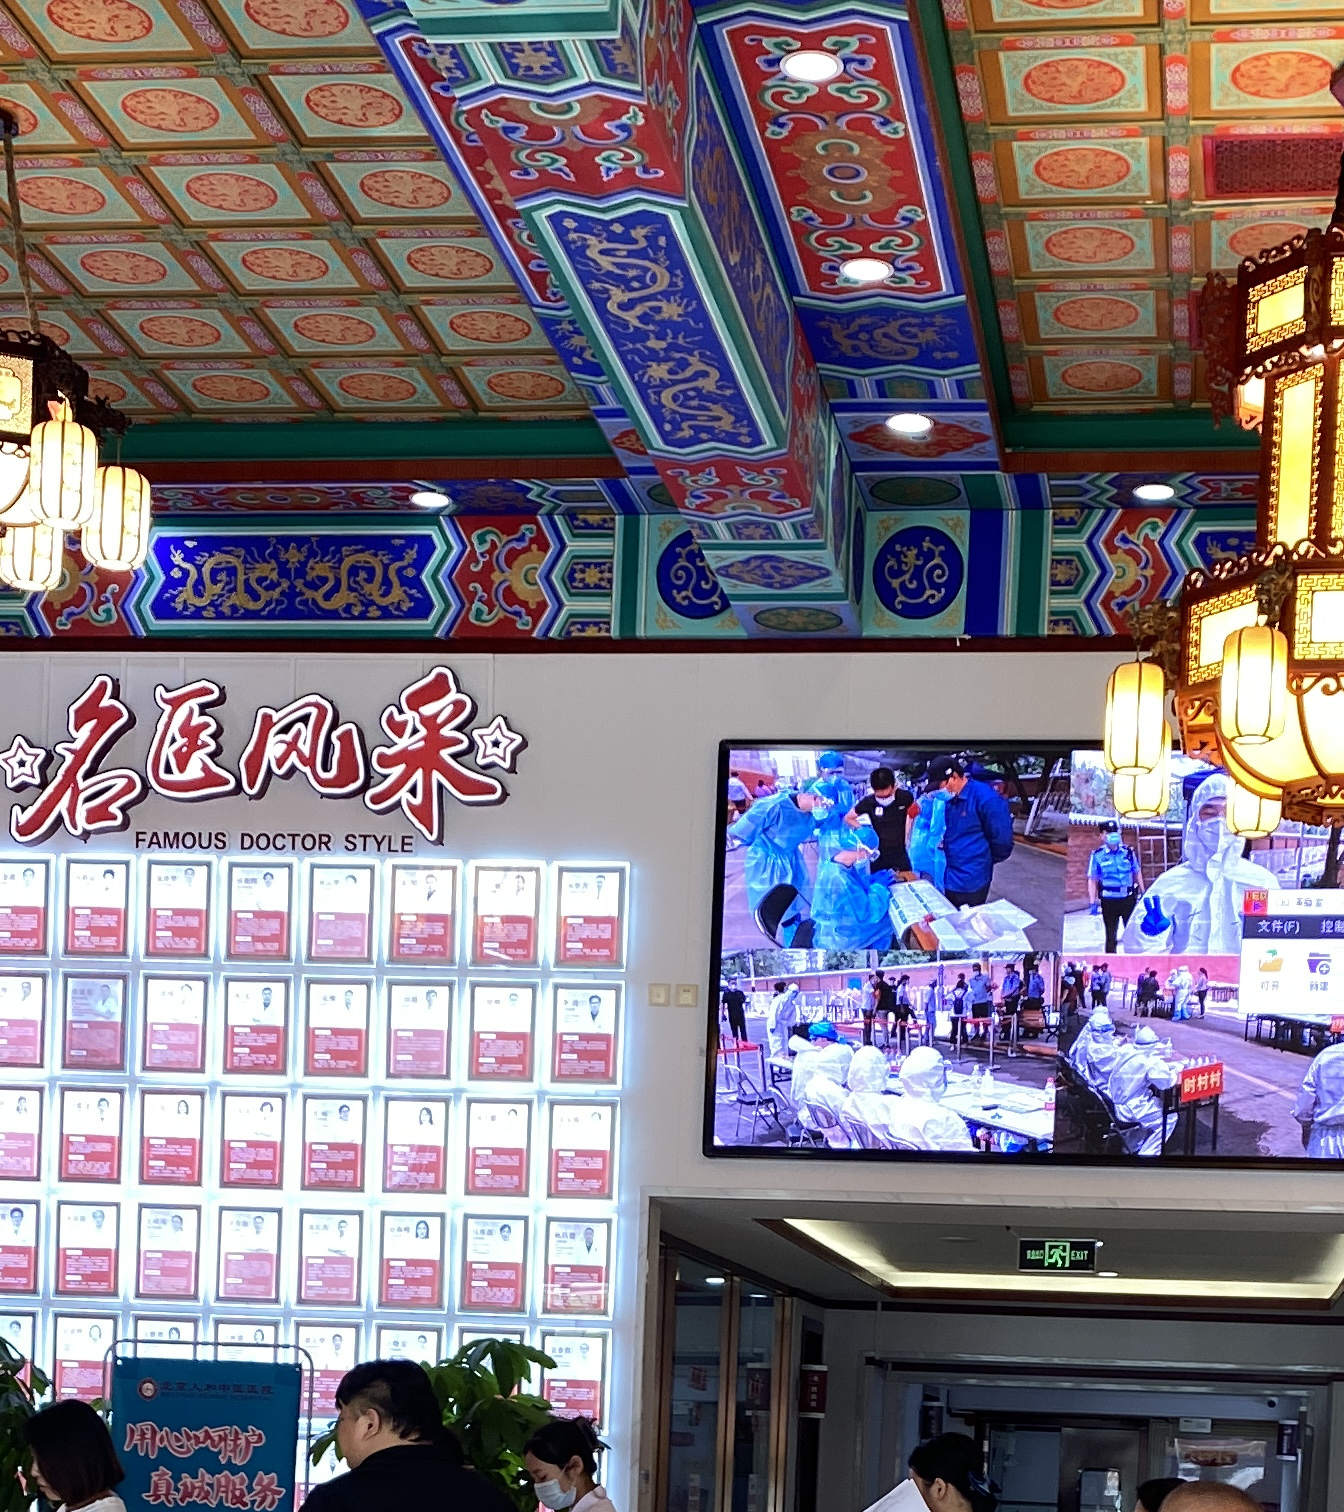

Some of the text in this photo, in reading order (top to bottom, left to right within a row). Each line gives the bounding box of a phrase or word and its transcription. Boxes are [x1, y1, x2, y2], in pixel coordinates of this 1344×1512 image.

[9, 664, 504, 844] 名医风采
[135, 831, 414, 853] FAMOUS DOCTOR STYLE
[1070, 1250, 1089, 1261] EXIT
[124, 1421, 265, 1466] 用心呵护
[142, 1466, 286, 1512] 真诚服务
